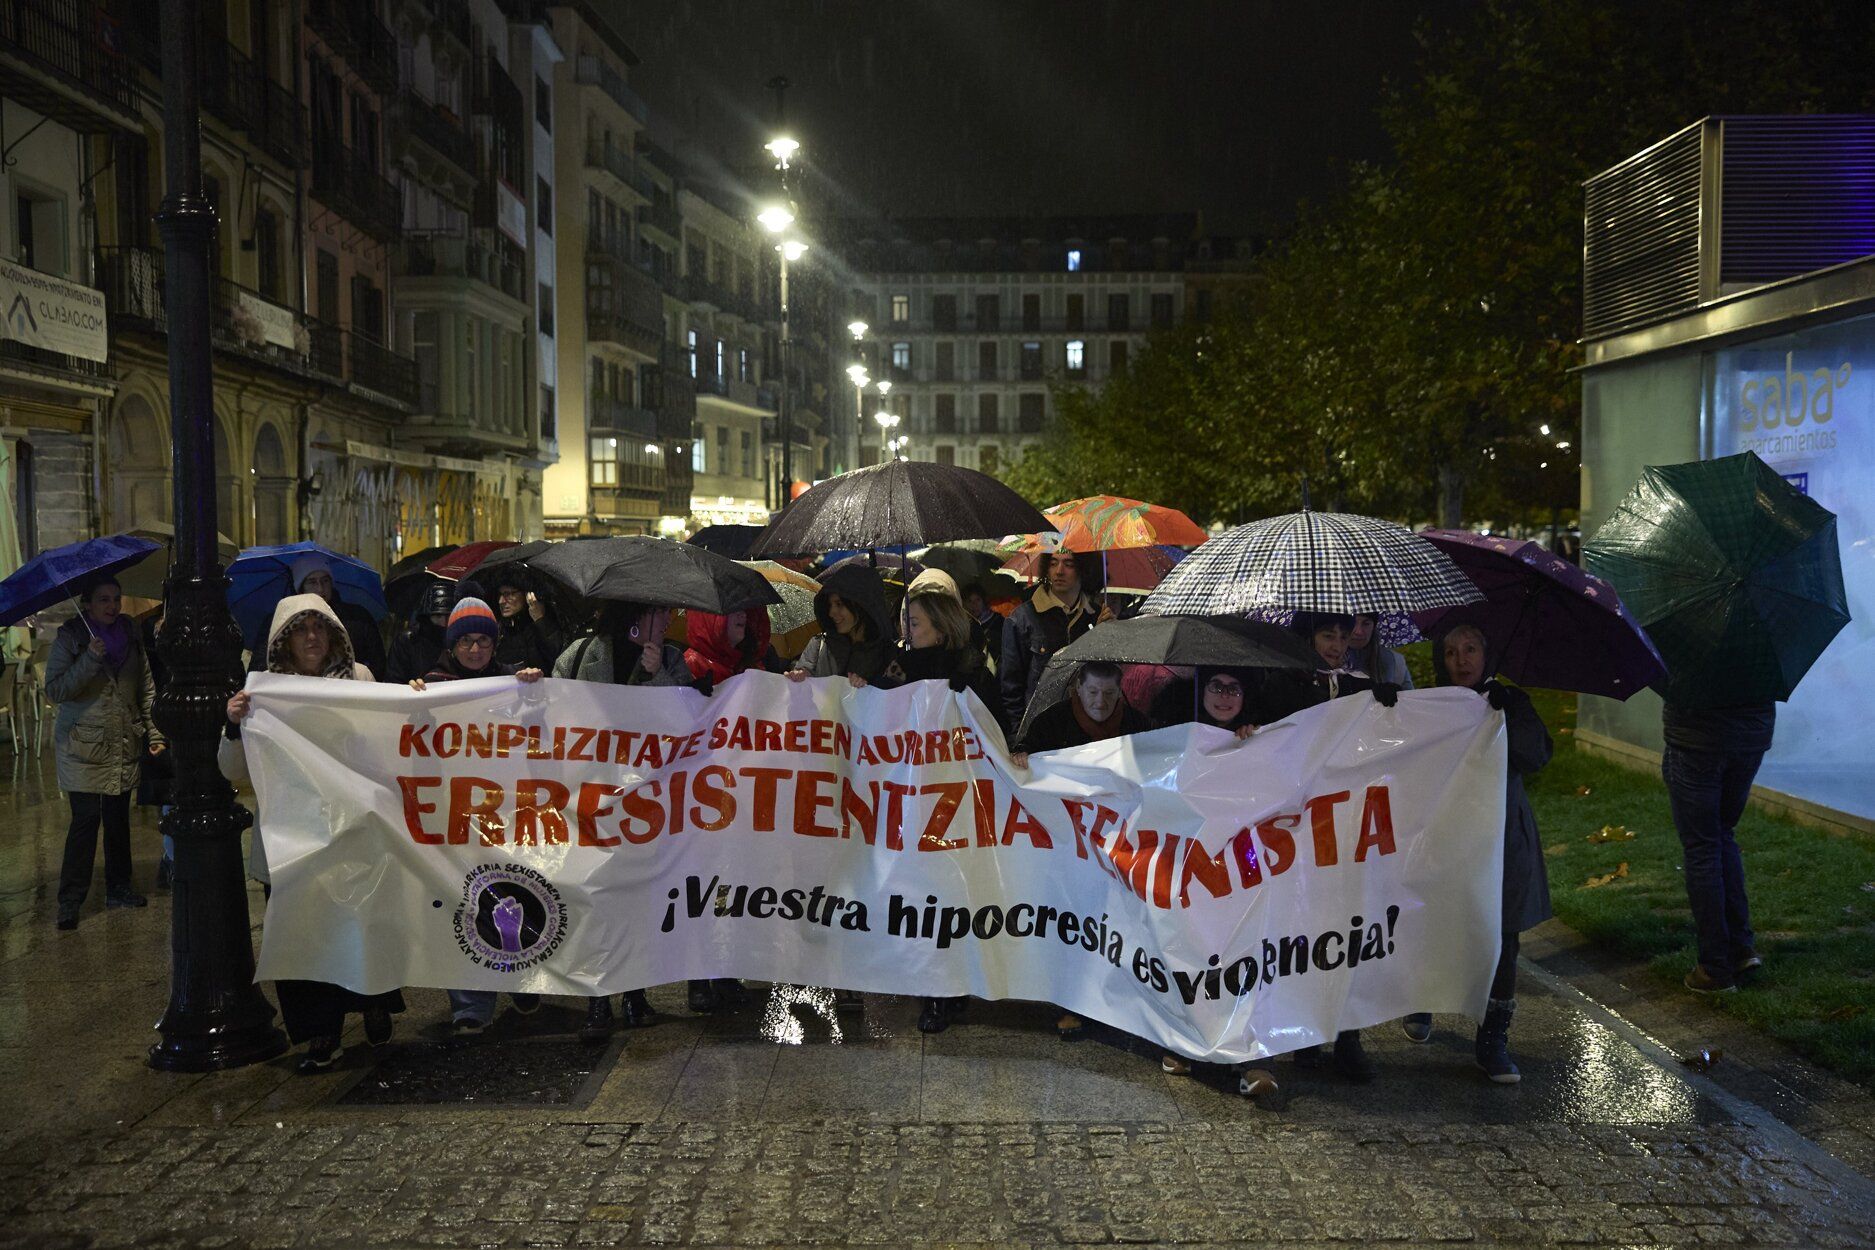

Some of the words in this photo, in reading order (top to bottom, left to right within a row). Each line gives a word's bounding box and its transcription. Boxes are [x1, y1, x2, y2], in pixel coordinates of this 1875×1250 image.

[1741, 429, 1837, 455] aparcamientos
[399, 721, 706, 769] KONPLIZITATE
[708, 715, 853, 756] SAREEN
[397, 764, 1054, 852] ERRESISTENTZIA
[1061, 785, 1397, 910] FEMINISTA
[505, 863, 561, 901] SEXISTAREN
[514, 875, 528, 885] DE
[453, 907, 482, 965] PLATAFORMA
[550, 902, 568, 949] AURKAKO
[661, 874, 872, 933] ¡Vuestra
[1132, 946, 1169, 994] es
[1172, 904, 1400, 1005] vioencia!
[473, 938, 519, 961] VIOLENCIA
[484, 946, 553, 973] EMAKUMEON
[521, 949, 535, 958] LA
